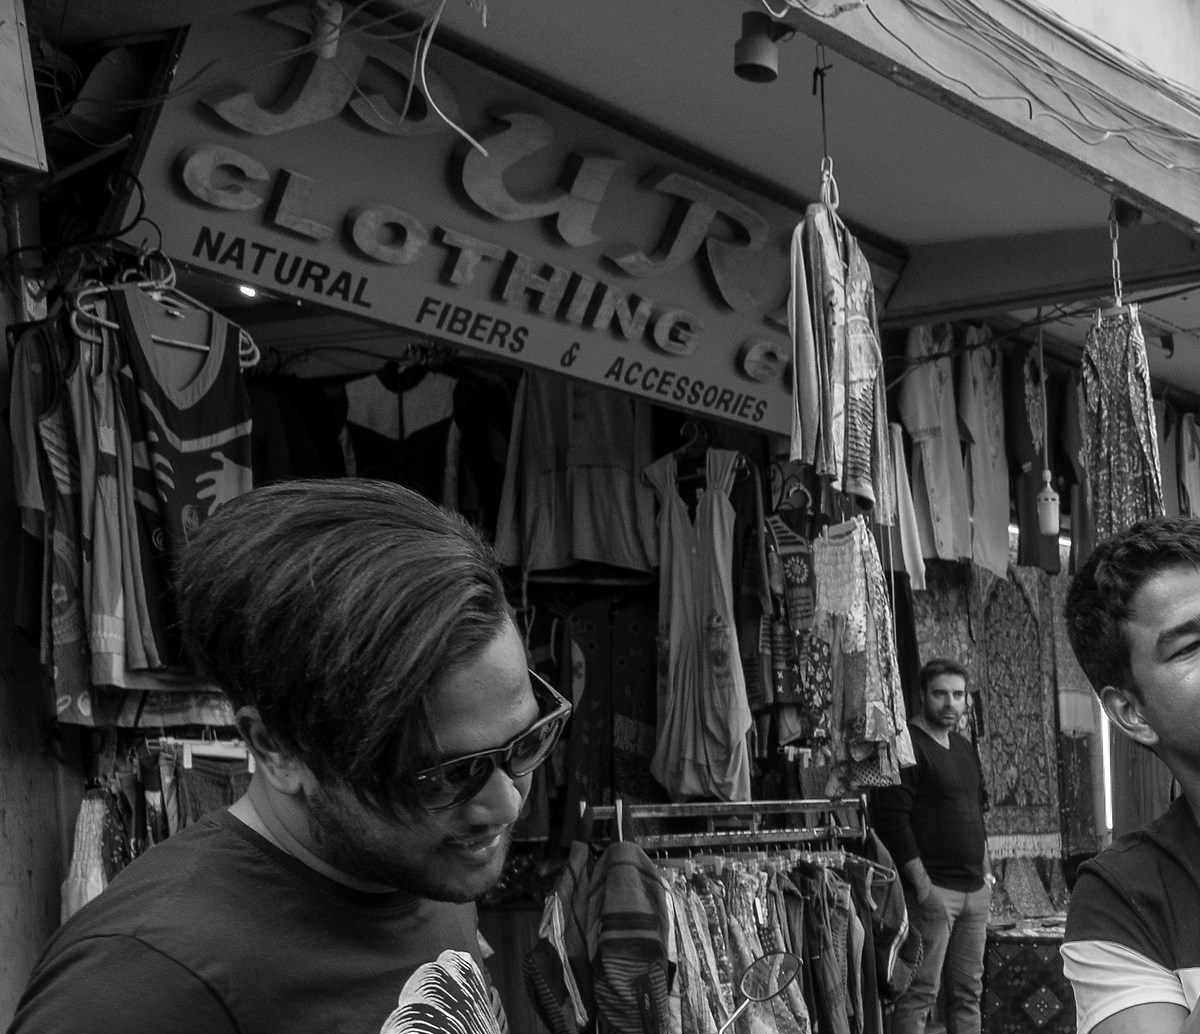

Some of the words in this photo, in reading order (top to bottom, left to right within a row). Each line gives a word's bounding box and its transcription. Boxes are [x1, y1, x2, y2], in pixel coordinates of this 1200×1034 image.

[182, 143, 705, 358] CLOTHING
[193, 226, 373, 309] NATURAL
[416, 297, 530, 354] FIBERS
[560, 342, 581, 368] &
[604, 356, 768, 424] ACCESSORIES
